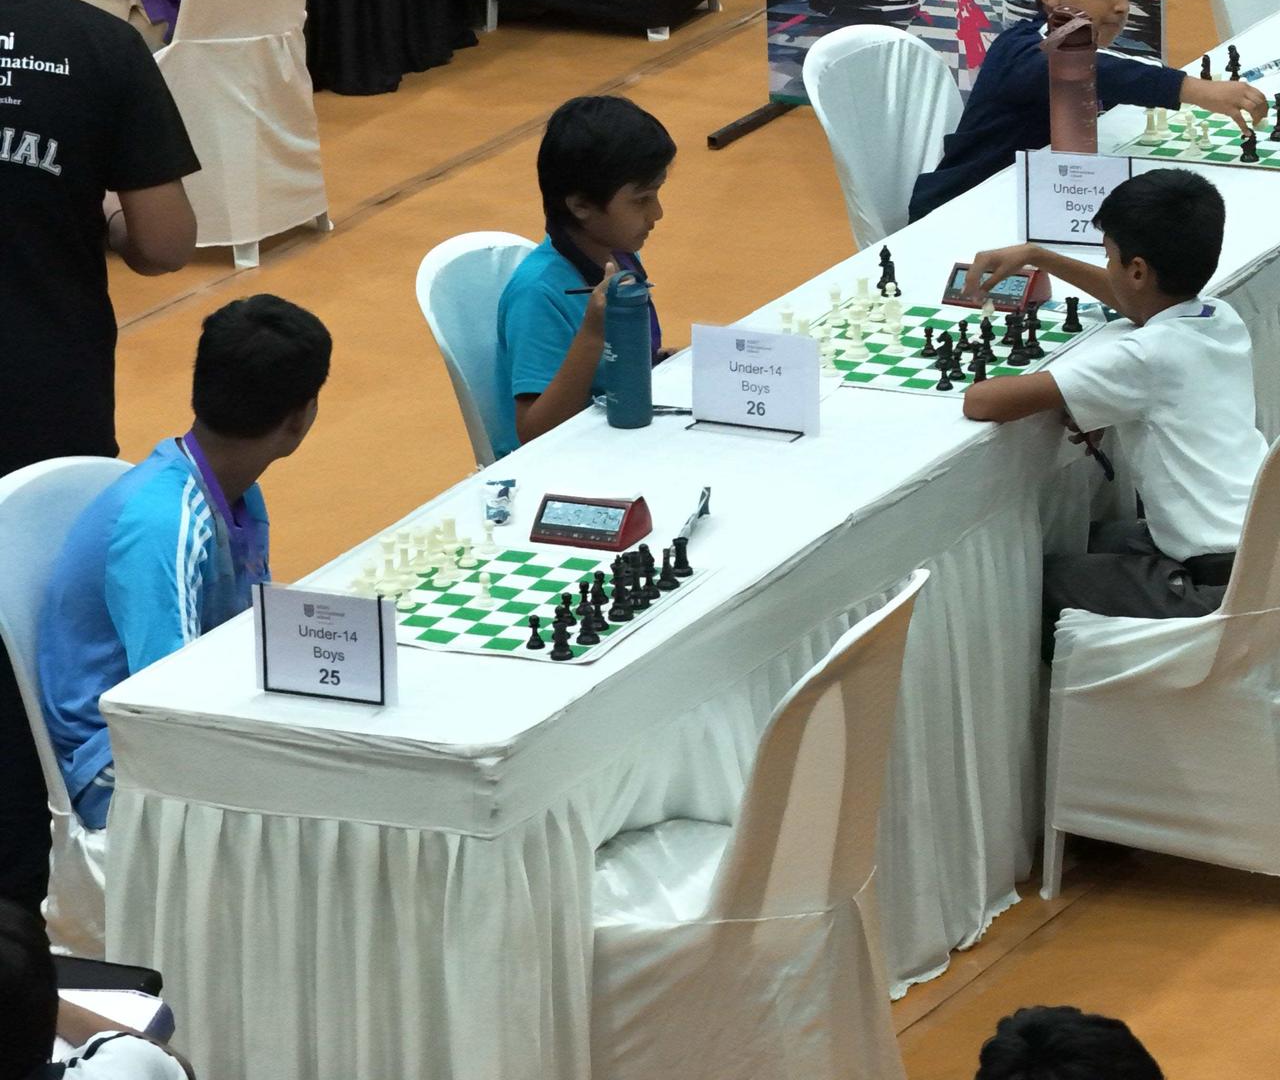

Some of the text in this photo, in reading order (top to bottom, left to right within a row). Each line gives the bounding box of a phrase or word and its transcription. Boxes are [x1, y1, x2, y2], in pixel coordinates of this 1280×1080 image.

[1054, 184, 1105, 196] Under-14
[1066, 201, 1094, 213] Boys
[1070, 219, 1090, 233] 27
[729, 360, 782, 376] Under-14
[741, 381, 770, 394] Boys
[746, 401, 766, 416] 26
[300, 624, 359, 643] Under-14
[314, 646, 346, 663] Boys
[320, 668, 341, 686] 25
